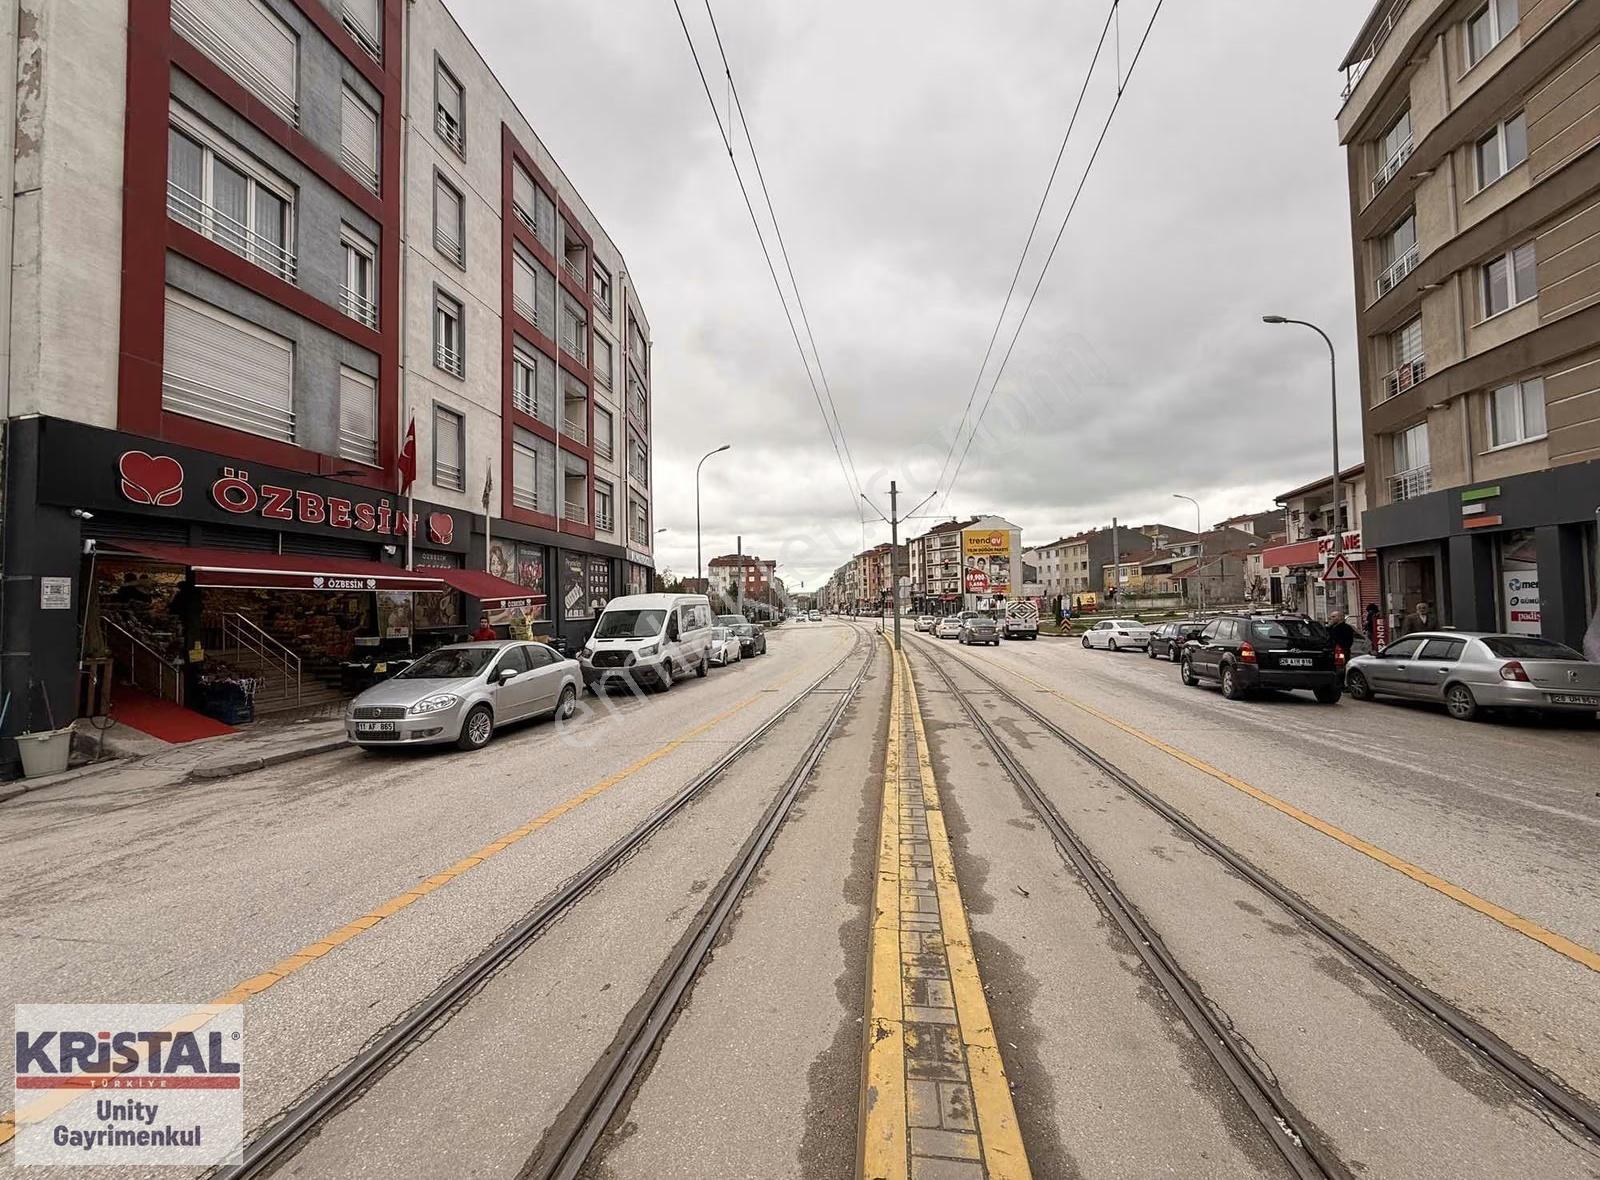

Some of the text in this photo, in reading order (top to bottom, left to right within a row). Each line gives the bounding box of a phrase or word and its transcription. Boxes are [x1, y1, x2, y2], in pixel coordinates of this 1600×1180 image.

[212, 466, 418, 538] ÖZBESİN
[1319, 534, 1361, 554] ECNE
[328, 578, 363, 588] ÖZBESİN
